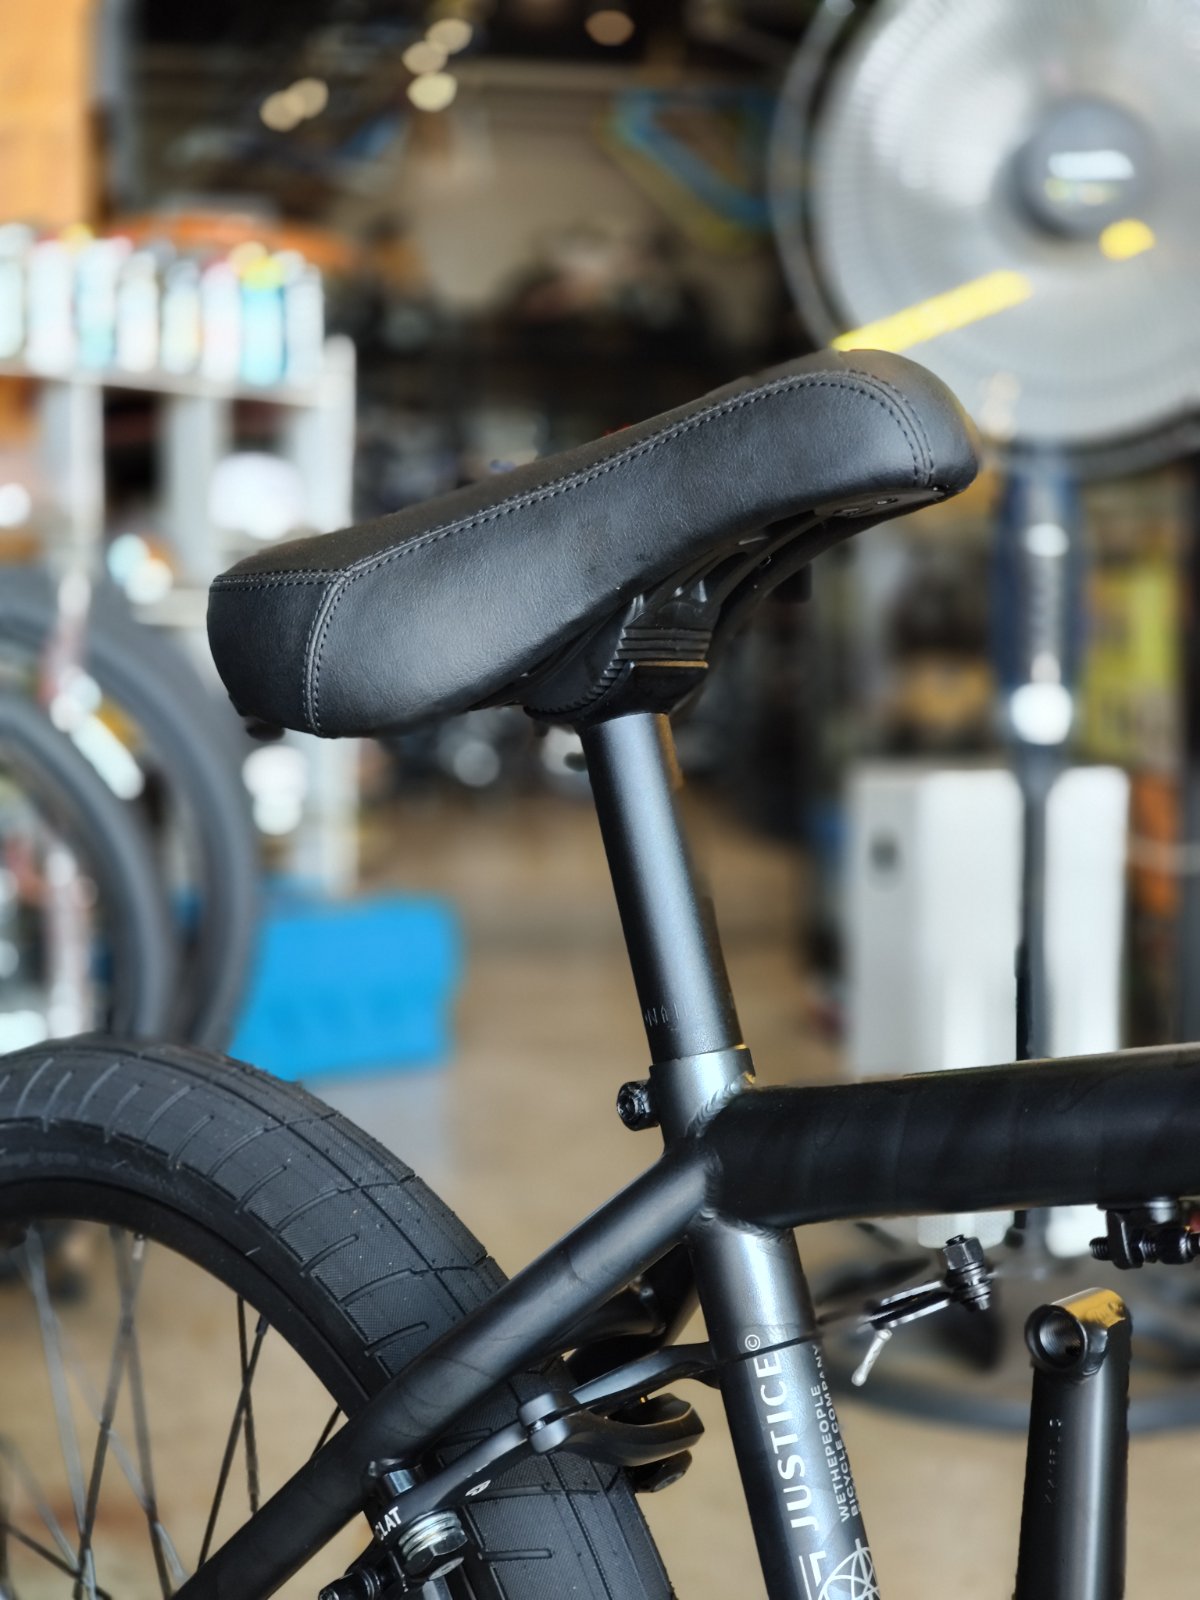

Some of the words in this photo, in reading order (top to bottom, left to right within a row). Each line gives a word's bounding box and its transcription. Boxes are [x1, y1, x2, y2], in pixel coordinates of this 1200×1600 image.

[754, 1352, 820, 1532] JUSTICE
[812, 1345, 840, 1432] COMPANY
[812, 1385, 850, 1523] WETHEPEOPLE
[835, 1439, 860, 1516] BICYCLE
